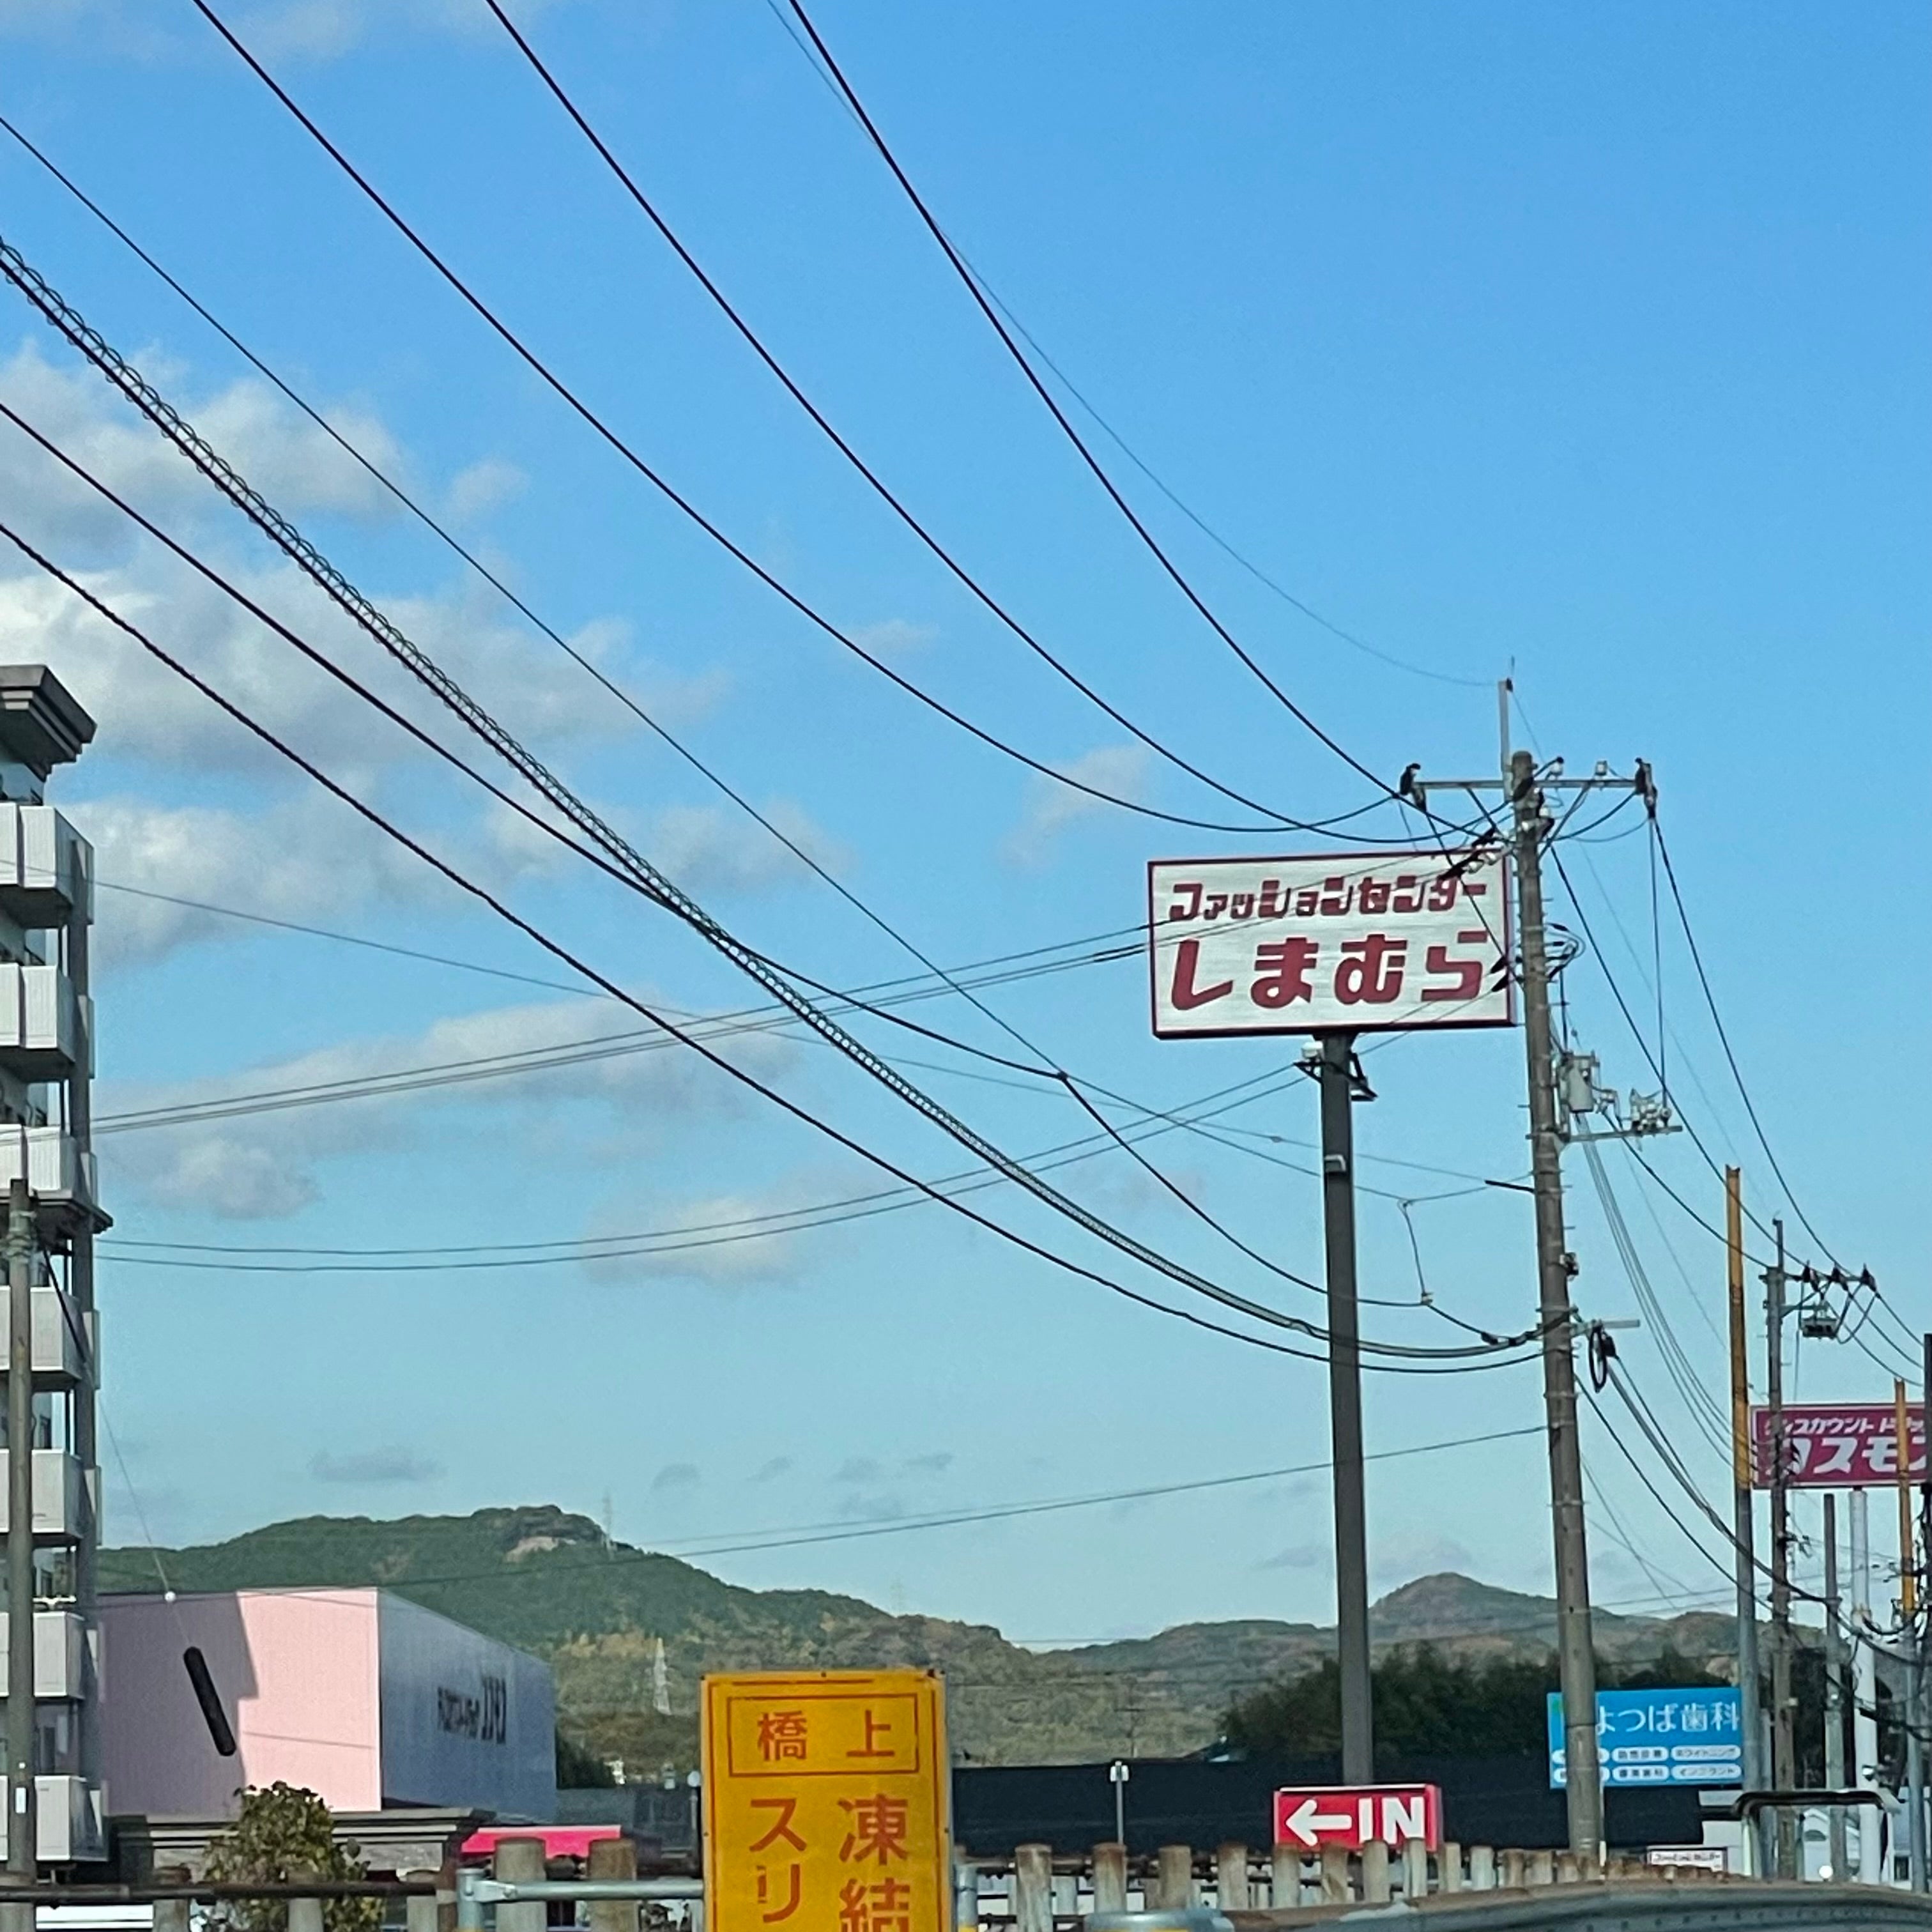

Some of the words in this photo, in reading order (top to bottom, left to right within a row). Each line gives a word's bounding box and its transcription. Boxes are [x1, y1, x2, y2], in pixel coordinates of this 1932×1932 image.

[1169, 875, 1487, 921] ファッションセンター
[1171, 930, 1489, 1010] しまむら
[1596, 1701, 1740, 1736] よつば歯科
[1358, 1797, 1425, 1845] IN
[749, 1798, 808, 1922] スリ
[837, 1793, 910, 1932] 凍結
